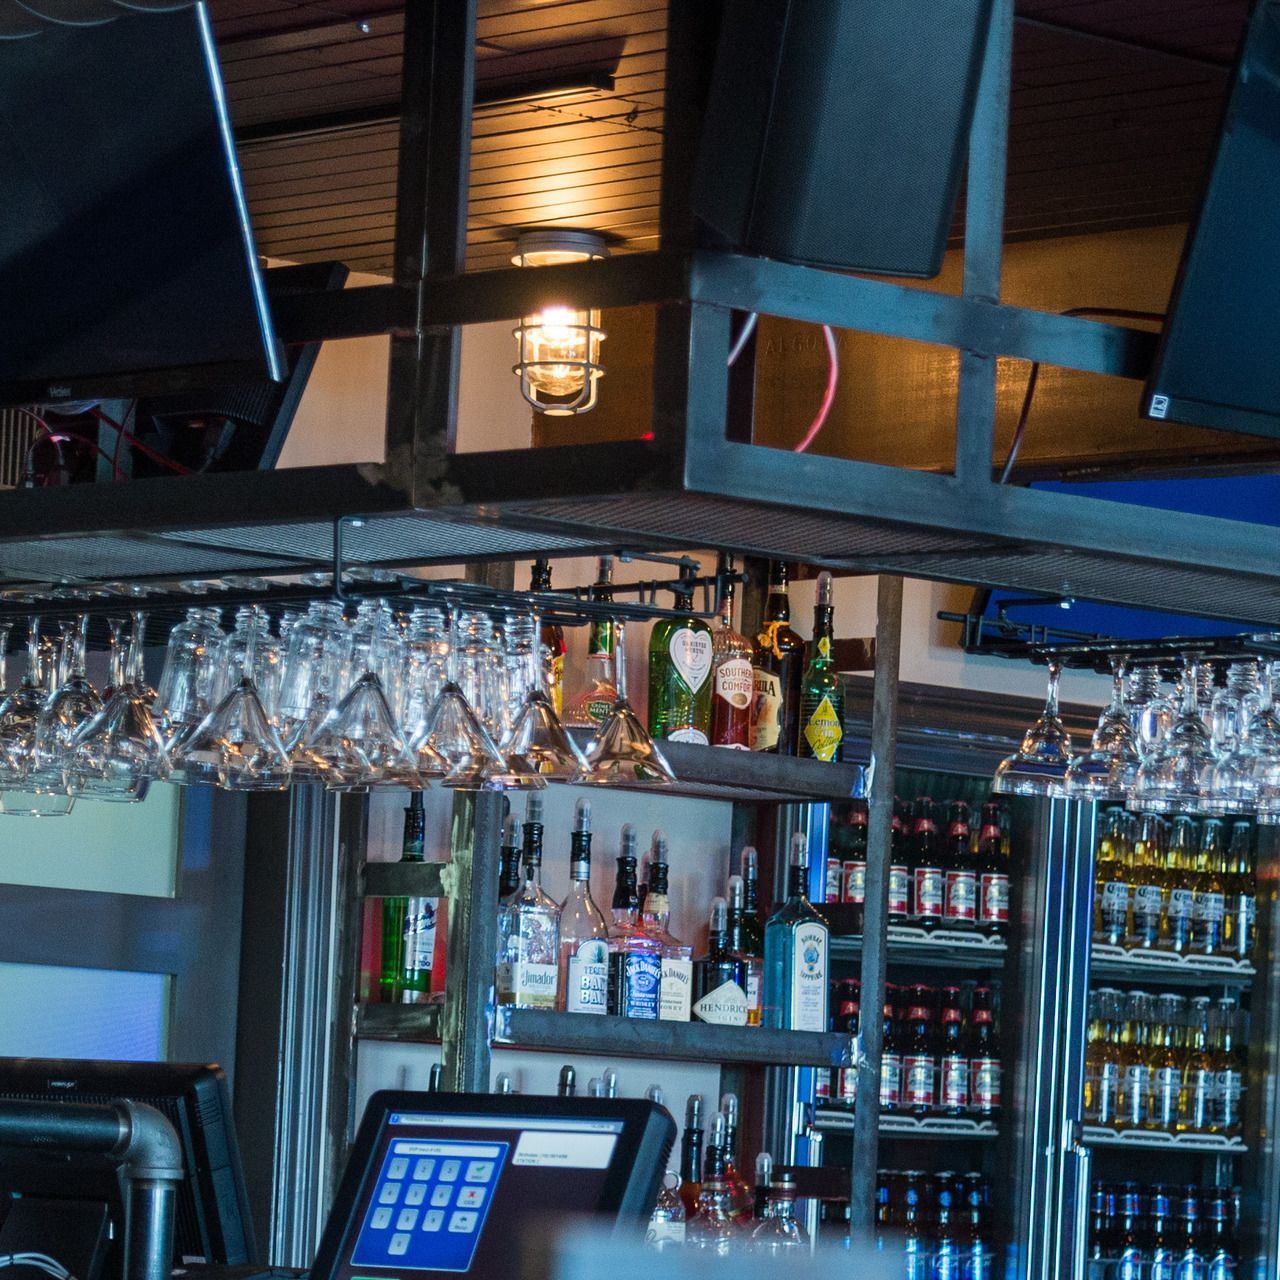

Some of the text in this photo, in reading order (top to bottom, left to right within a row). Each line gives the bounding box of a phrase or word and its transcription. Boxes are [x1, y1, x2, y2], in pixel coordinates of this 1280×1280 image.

[720, 667, 752, 678] SOUTHER
[722, 681, 752, 693] COMFO
[809, 718, 840, 728] Lemon
[522, 969, 556, 987] Jimador
[700, 1003, 748, 1013] HENDRIC
